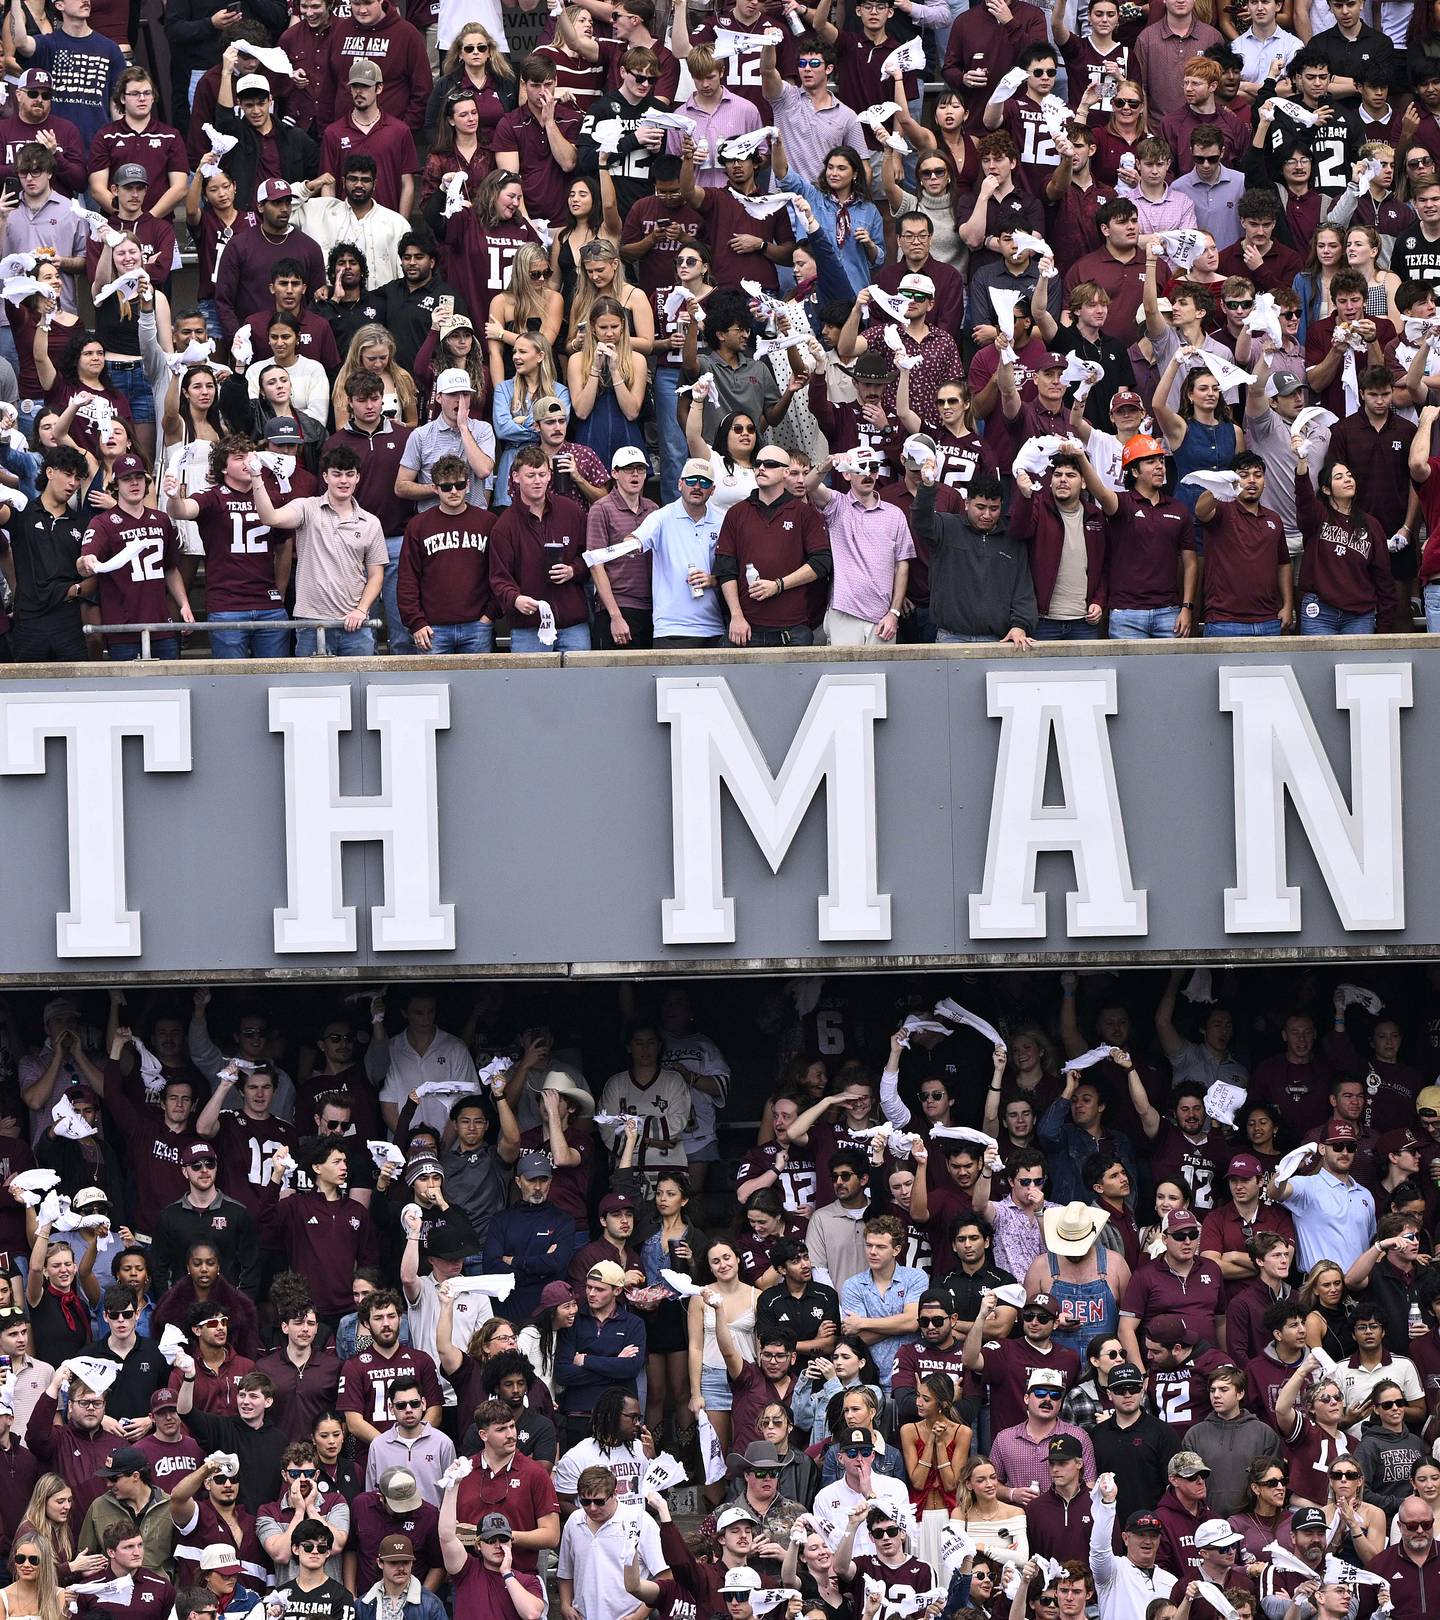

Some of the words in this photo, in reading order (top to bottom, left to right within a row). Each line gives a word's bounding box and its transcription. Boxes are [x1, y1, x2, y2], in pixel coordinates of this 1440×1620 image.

[343, 37, 365, 51] TEXAS
[366, 37, 390, 52] A&M
[1327, 126, 1347, 139] A&M
[1020, 121, 1062, 166] 12
[1405, 254, 1435, 268] TEXAS
[962, 449, 979, 463] A&M
[227, 501, 253, 514] TEXAS
[120, 529, 147, 541] TEXAS
[148, 527, 164, 538] A&M
[230, 512, 271, 554] 12
[424, 531, 460, 556] TEXAS
[462, 531, 488, 554] A&M
[657, 663, 1413, 943] MAN
[817, 1010, 847, 1055] 6
[154, 1140, 179, 1161] TEXAS
[778, 1171, 816, 1212] 12
[1062, 1298, 1104, 1324] BEN
[368, 1368, 395, 1379] TEXAS
[397, 1367, 415, 1378] A&M
[918, 1360, 944, 1371] TEXAS
[945, 1361, 963, 1372] A&M
[1156, 1370, 1177, 1382] TEXAS
[1178, 1368, 1191, 1380] A&M
[1156, 1381, 1192, 1423] 12
[155, 1455, 197, 1477] AGGIES
[1381, 1449, 1421, 1466] TEXAS
[1383, 1464, 1413, 1483] AGG
[311, 1602, 332, 1615] A&M
